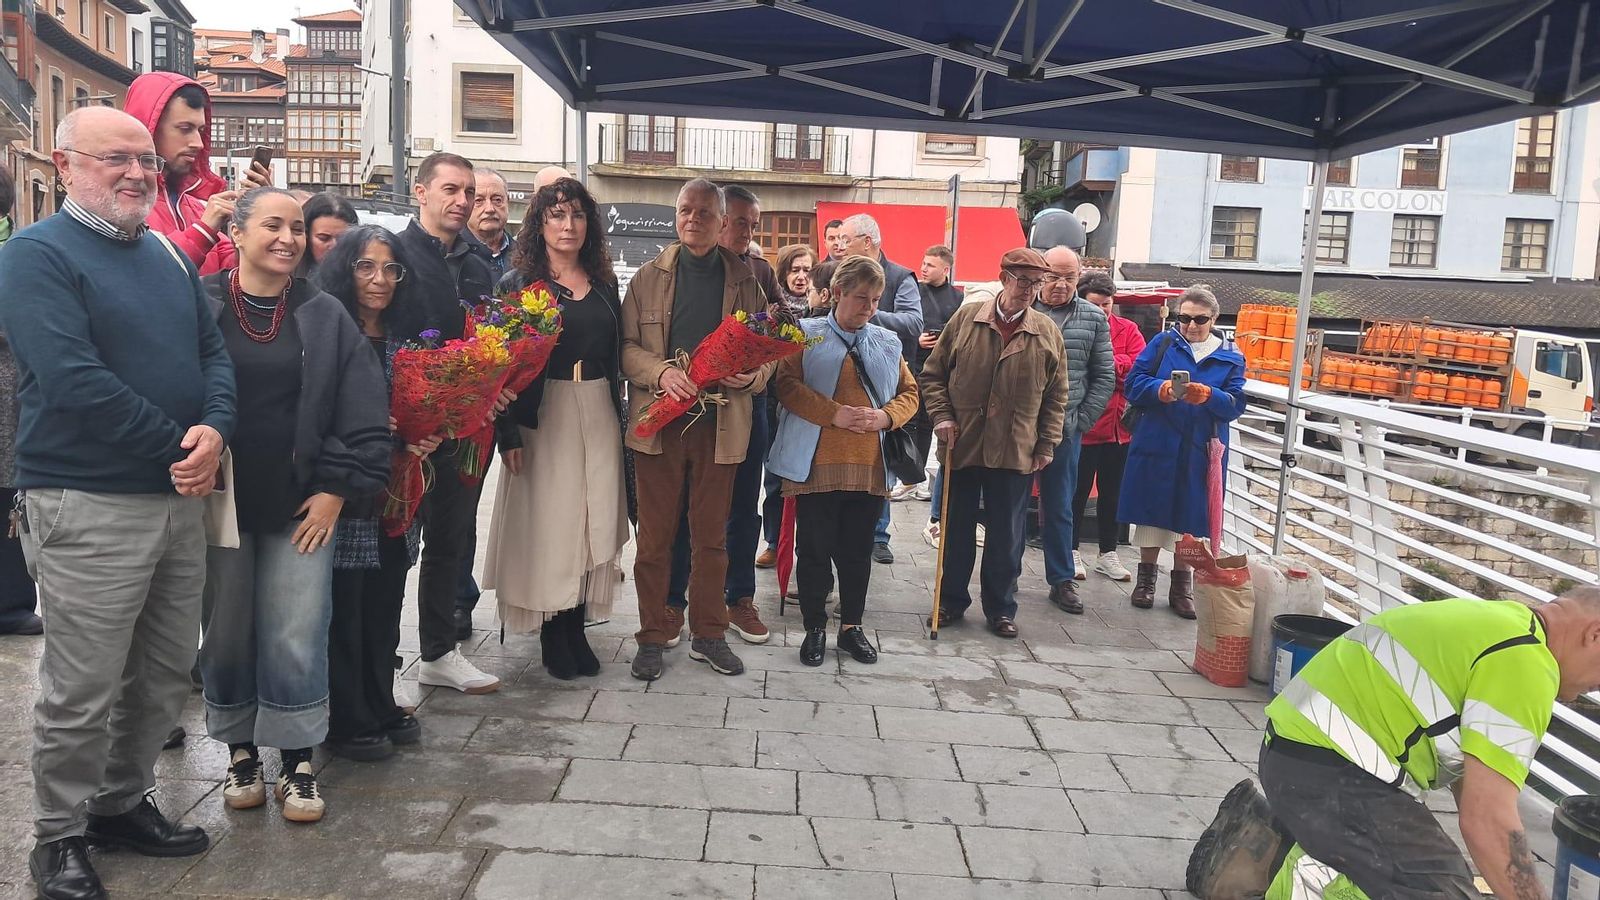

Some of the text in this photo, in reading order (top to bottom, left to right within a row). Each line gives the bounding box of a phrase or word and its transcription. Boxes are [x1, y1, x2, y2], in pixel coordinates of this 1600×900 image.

[507, 191, 525, 200] ITO
[1308, 189, 1445, 211] AR COLON
